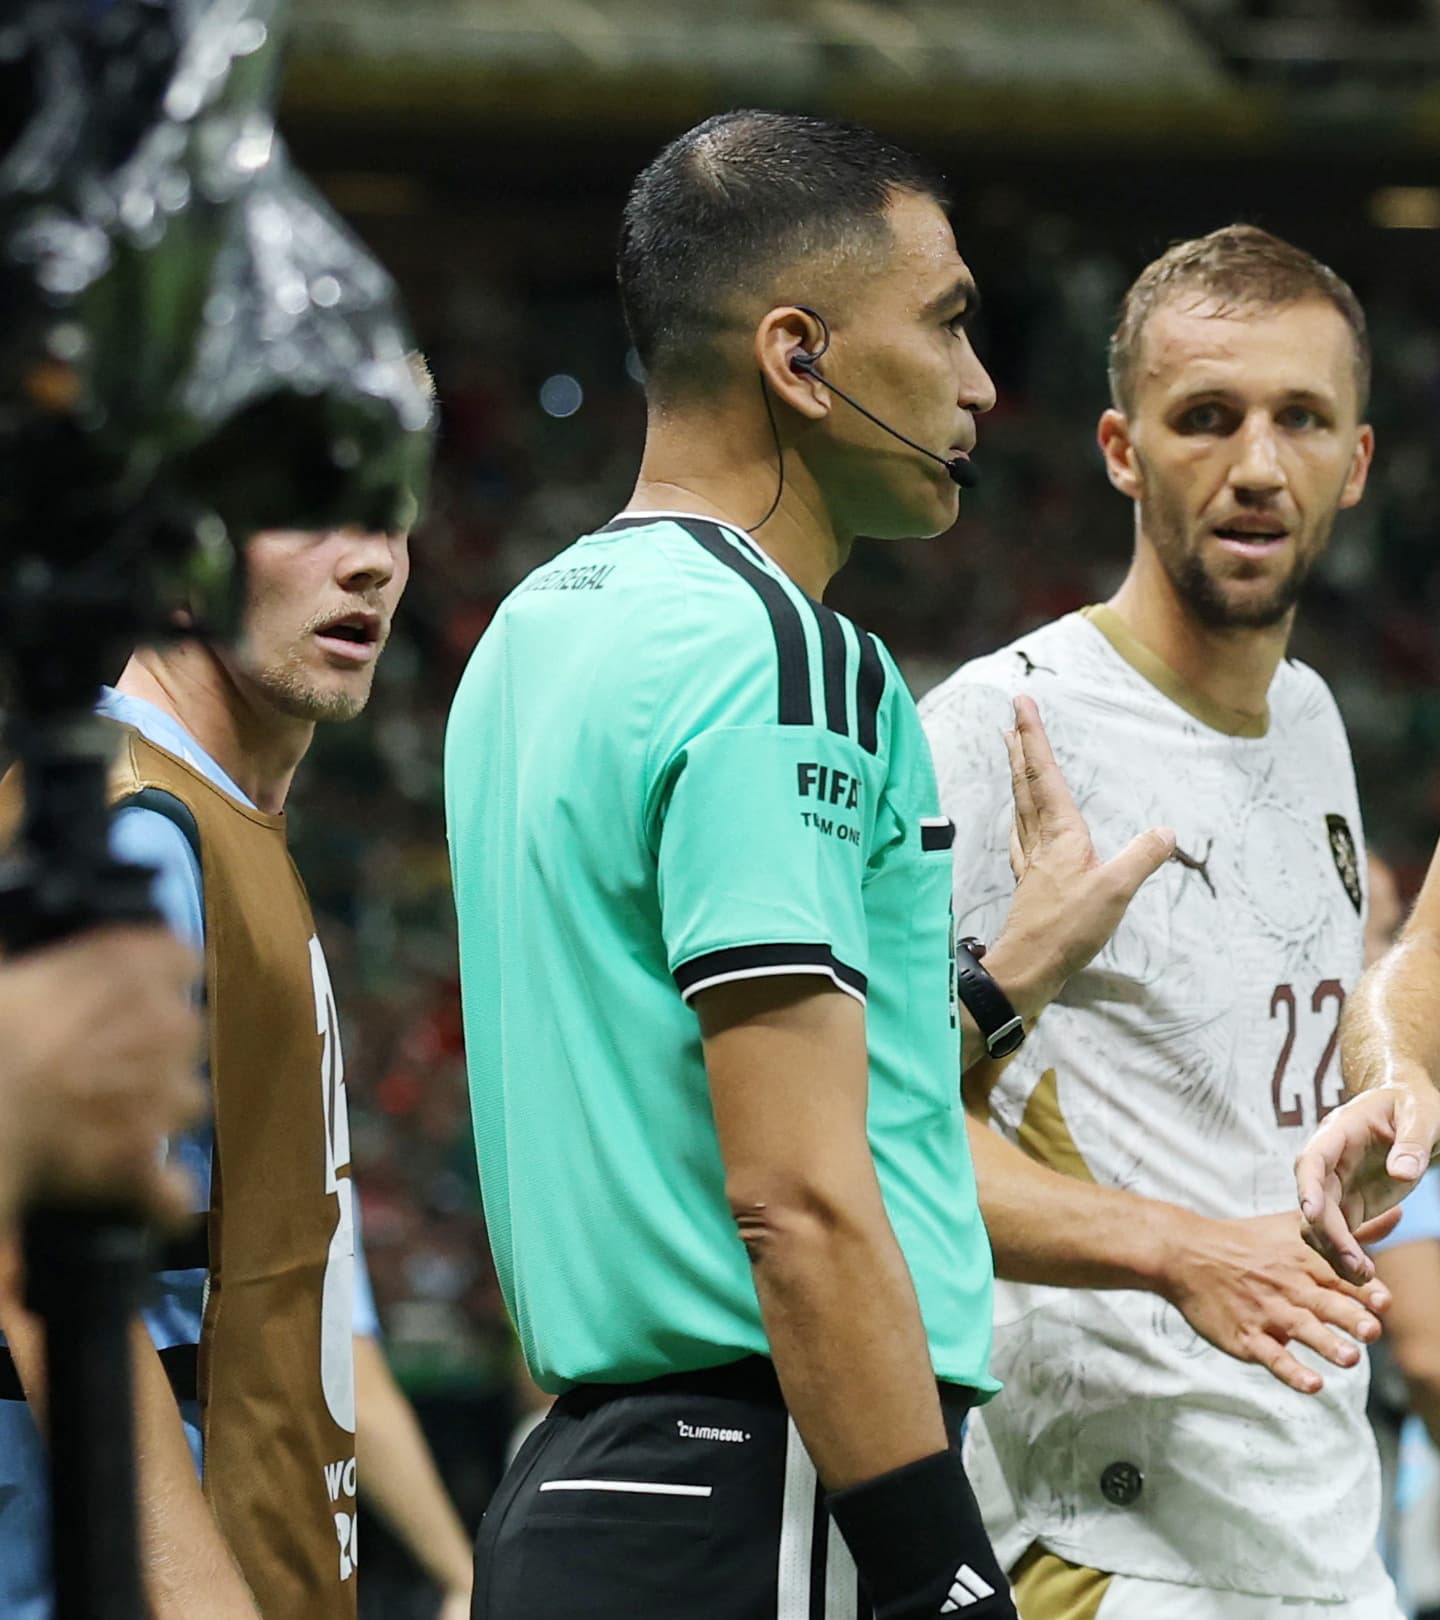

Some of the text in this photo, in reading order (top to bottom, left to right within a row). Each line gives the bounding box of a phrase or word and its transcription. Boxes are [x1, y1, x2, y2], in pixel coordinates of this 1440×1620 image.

[797, 763, 862, 810] FIFA
[801, 812, 861, 846] TM ONE
[1270, 979, 1351, 1128] 22
[679, 1424, 745, 1443] CLIMACOOL
